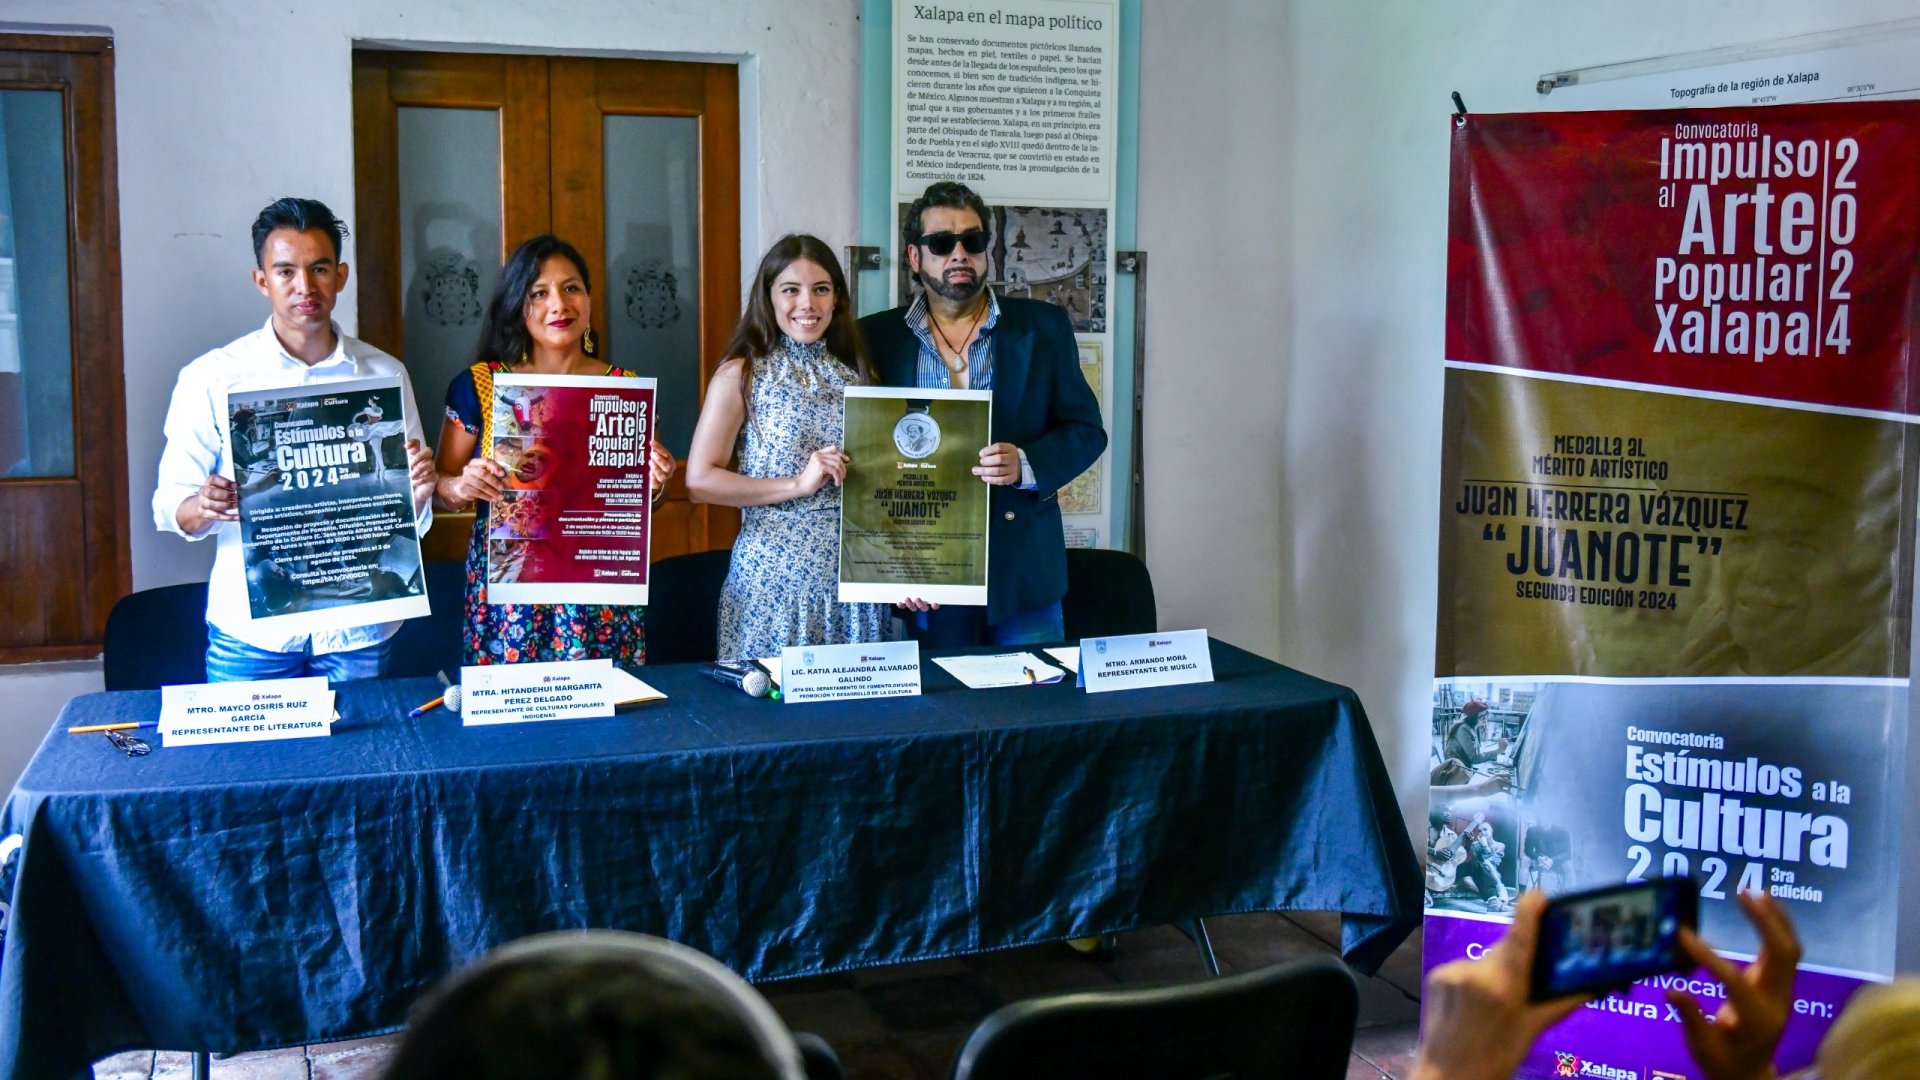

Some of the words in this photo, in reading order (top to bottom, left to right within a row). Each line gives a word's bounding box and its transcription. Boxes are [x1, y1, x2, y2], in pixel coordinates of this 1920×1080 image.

[914, 6, 964, 24] Xalapa
[968, 12, 985, 23] en
[989, 10, 1002, 24] el
[1005, 14, 1045, 29] mapa
[1049, 15, 1102, 30] político
[907, 34, 916, 42] Se
[919, 35, 934, 43] han
[937, 37, 979, 46] conservado
[982, 39, 1028, 48] documentos
[1030, 41, 1066, 51] pictóricos
[1069, 44, 1102, 53] llamados
[908, 47, 934, 55] mapas,
[938, 47, 964, 56] hechos
[981, 50, 997, 59] piel,
[1001, 51, 1028, 60] textiles
[1040, 54, 1061, 63] papel.
[1670, 85, 1715, 99] Topografía
[1717, 82, 1728, 93] de
[1730, 81, 1739, 92] la
[1741, 77, 1769, 92] región
[1772, 75, 1784, 87] de
[1786, 71, 1820, 87] Xalapa
[1675, 121, 1758, 140] Convocatoria
[916, 160, 943, 169] México
[946, 161, 1001, 171] independiente,
[1029, 165, 1079, 174] promulgación
[1082, 165, 1090, 173] de
[1659, 135, 1817, 185] Impulso
[906, 171, 955, 180] Constitución
[957, 172, 966, 180] de
[968, 173, 985, 181] 1824.
[1659, 182, 1675, 208] al
[1678, 182, 1815, 256] Arte
[1655, 257, 1812, 307] Popular
[1653, 303, 1810, 362] Xalapa
[590, 398, 636, 414] Impulso
[274, 419, 313, 429] Convocatoria
[589, 413, 596, 421] al
[596, 413, 635, 436] Arte
[274, 425, 346, 445] Estímulos
[348, 430, 354, 438] a
[355, 428, 364, 437] la
[588, 435, 634, 452] Popular
[277, 441, 367, 471] Cultura
[588, 450, 634, 469] Xalapa
[1532, 454, 1585, 478] MÉRITO
[1590, 456, 1668, 481] ARTÍSTICO
[281, 467, 339, 491] 2024
[1580, 586, 1634, 608] EDICIÓN
[1638, 592, 1676, 611] 2024
[832, 666, 877, 674] ALEJANDRA
[878, 664, 918, 672] ALVARADO
[1097, 668, 1158, 678] REPRESENTANTE
[1170, 663, 1197, 671] MÚSICA
[1105, 660, 1128, 668] MTRO.
[1130, 657, 1165, 666] ARMANDO
[1166, 654, 1187, 662] MORA
[838, 675, 872, 684] GALINDO
[472, 688, 498, 697] MTRA.
[501, 685, 552, 696] HITANDEHUI
[555, 682, 602, 692] MARGARITA
[187, 706, 216, 714] MTRO.
[219, 704, 251, 713] MAYCO
[253, 702, 284, 710] OSIRIS
[471, 706, 524, 716] REPRESENTANTE
[535, 704, 568, 712] CULTURAS
[569, 702, 605, 710] POPULARES
[504, 696, 532, 705] PÉREZ
[533, 694, 573, 703] DELGADO
[231, 713, 266, 722] GARCÍA
[171, 725, 251, 736] REPRESENTANTE
[253, 724, 265, 732] DE
[267, 721, 323, 731] LITERATURA
[1627, 725, 1724, 750] Convocatoria
[1625, 744, 1802, 799] Estímulos
[1811, 782, 1826, 801] a
[1829, 780, 1851, 805] la
[1623, 783, 1850, 870] Cultura
[1770, 867, 1795, 884] 3ra
[1770, 884, 1823, 903] edición
[1793, 999, 1834, 1020] en:
[1580, 1060, 1638, 1080] Xalapa
